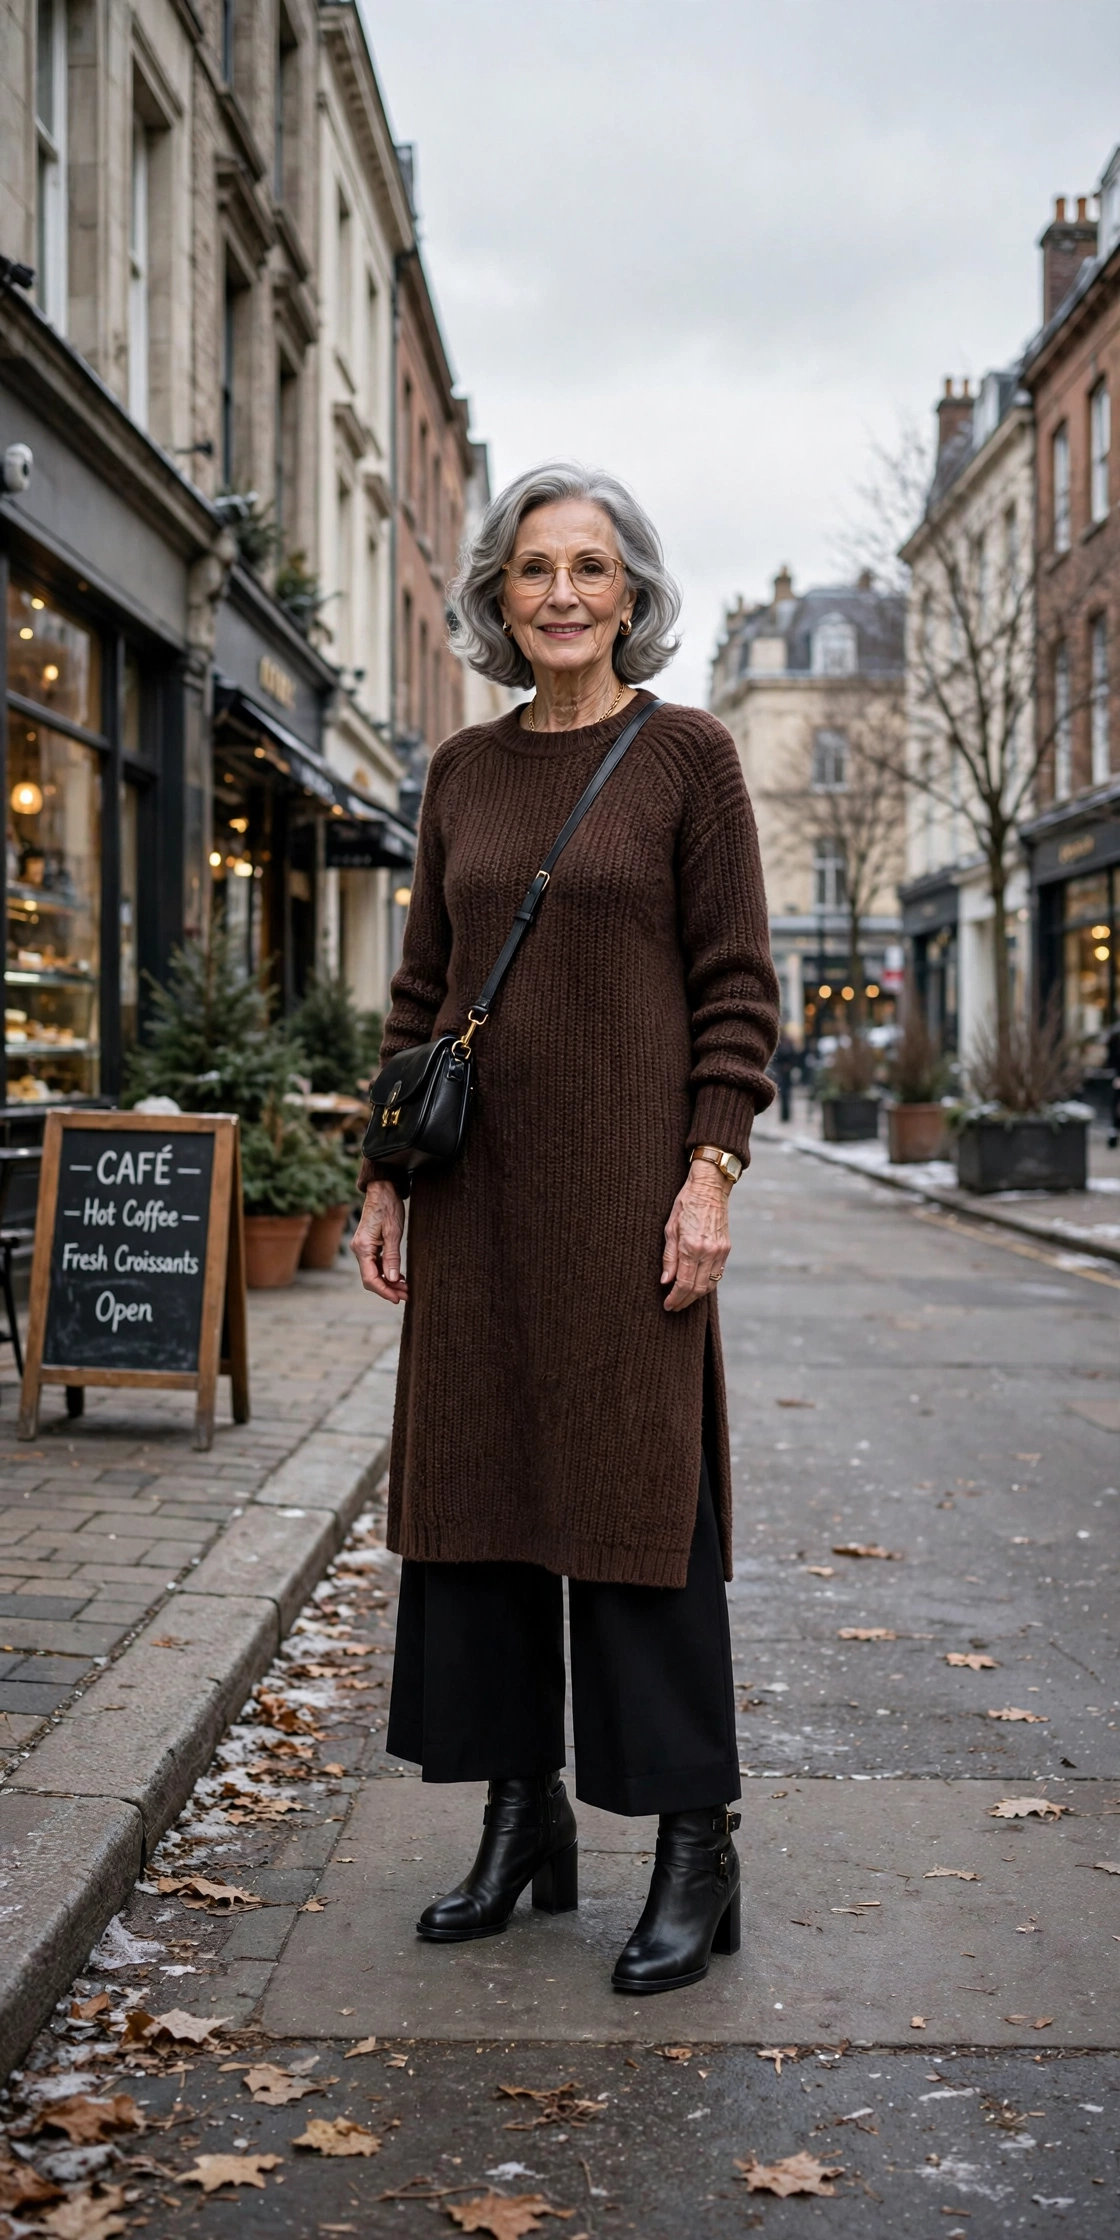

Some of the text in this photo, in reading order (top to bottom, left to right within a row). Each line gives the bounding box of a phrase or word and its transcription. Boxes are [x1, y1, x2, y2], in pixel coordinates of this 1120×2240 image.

[97, 1144, 173, 1185] CAFÉ
[83, 1197, 179, 1232] Hot Coffee
[62, 1243, 199, 1275] Fresh Croissants
[95, 1290, 153, 1332] Open
